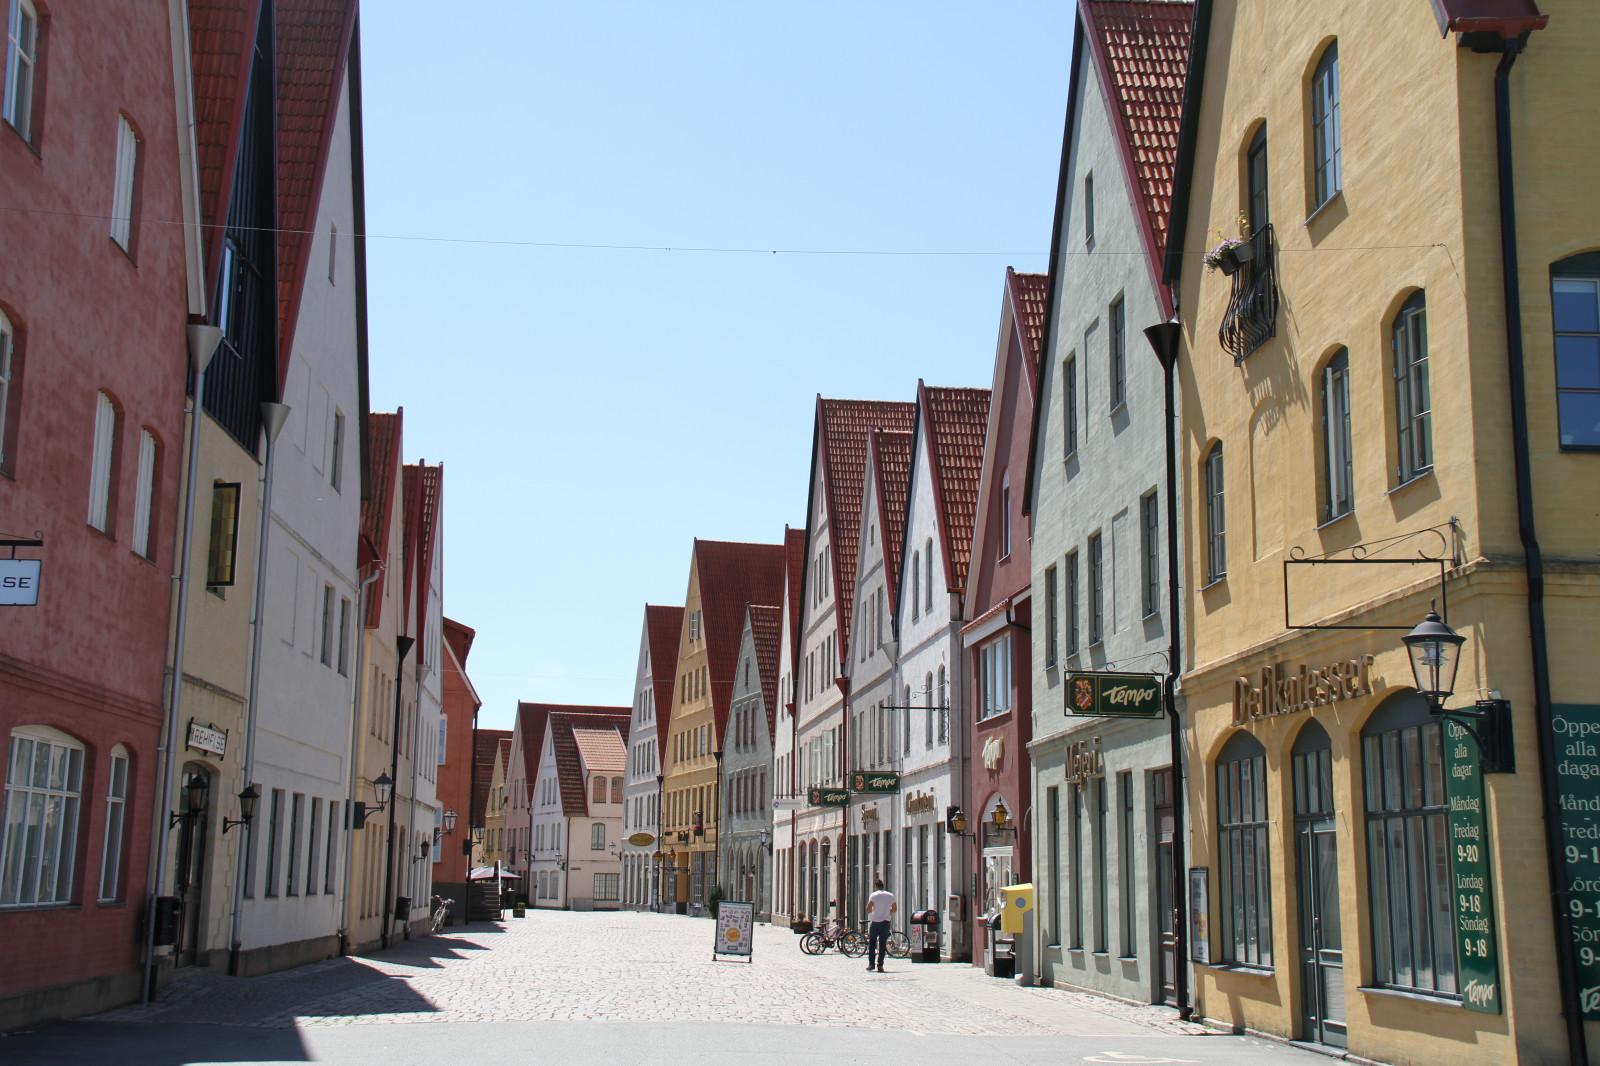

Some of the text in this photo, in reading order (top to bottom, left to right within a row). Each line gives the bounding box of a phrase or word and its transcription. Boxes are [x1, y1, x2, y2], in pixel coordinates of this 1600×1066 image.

[1102, 685, 1156, 707] tempo
[1231, 653, 1374, 727] Delikatesser
[1454, 743, 1468, 758] alla
[1565, 741, 1597, 756] alla
[1064, 736, 1101, 792] Mejeri
[1452, 763, 1472, 780] dagar
[868, 777, 896, 789] tempo
[1450, 796, 1479, 813] Måndag
[1454, 822, 1479, 841] Fredag
[1457, 844, 1478, 862] 9-20
[1457, 873, 1483, 893] Lördag
[1460, 894, 1480, 912] 9-18
[1460, 915, 1489, 934] Söndag
[1464, 979, 1495, 1007] tempo
